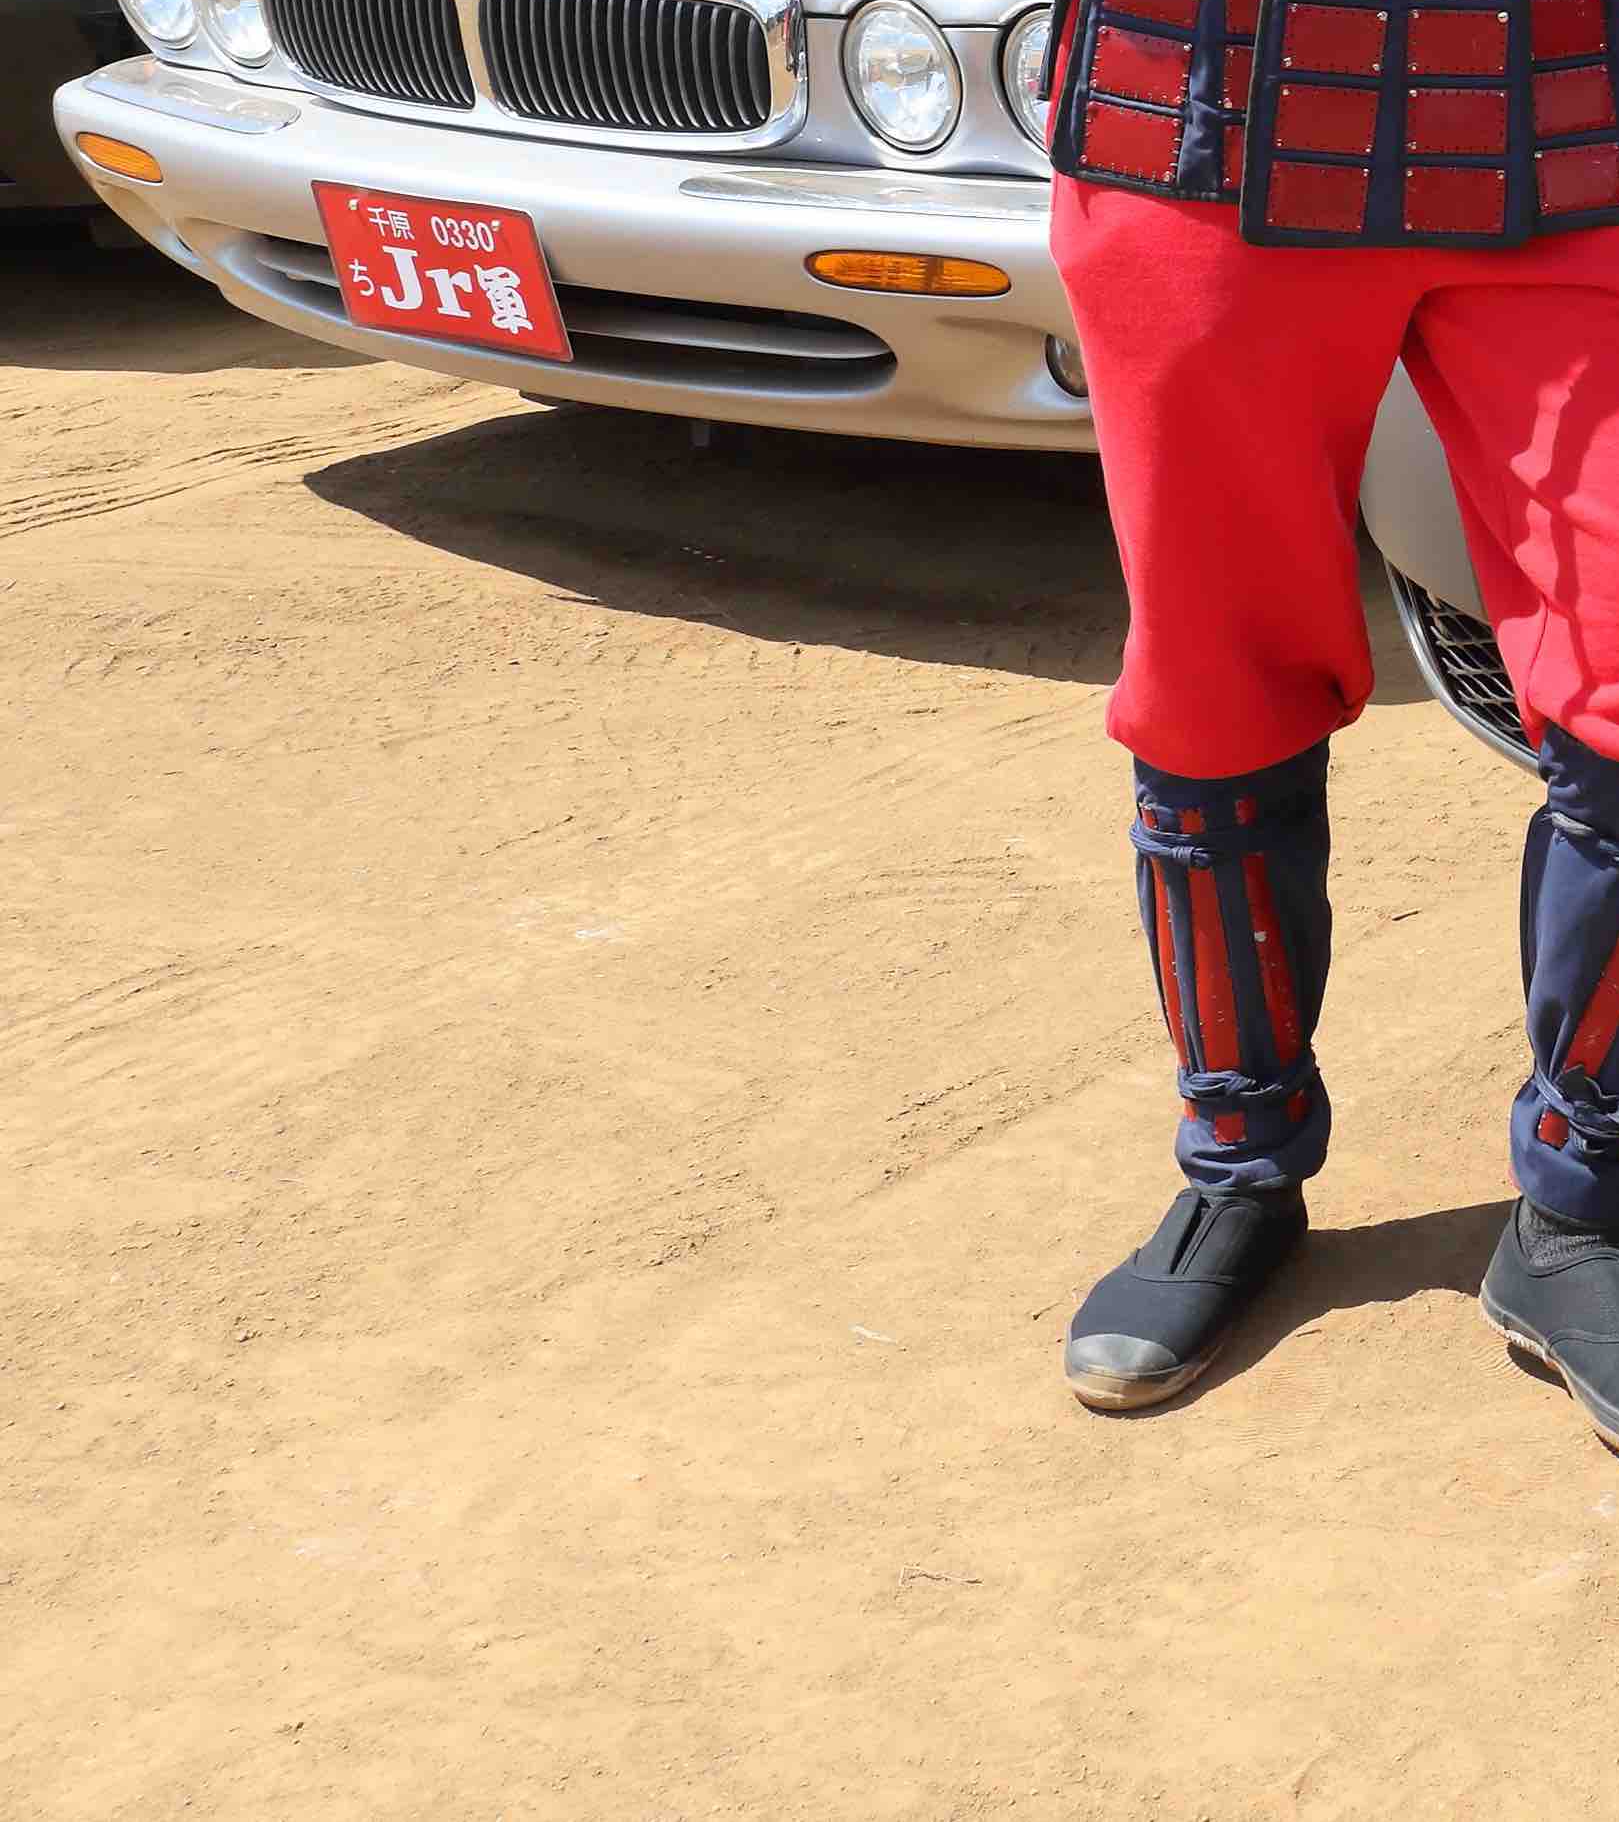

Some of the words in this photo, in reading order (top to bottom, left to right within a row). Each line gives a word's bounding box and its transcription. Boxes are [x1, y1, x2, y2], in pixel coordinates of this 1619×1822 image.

[367, 206, 415, 241] 千原
[430, 215, 495, 253] 0330
[348, 258, 376, 298] ち
